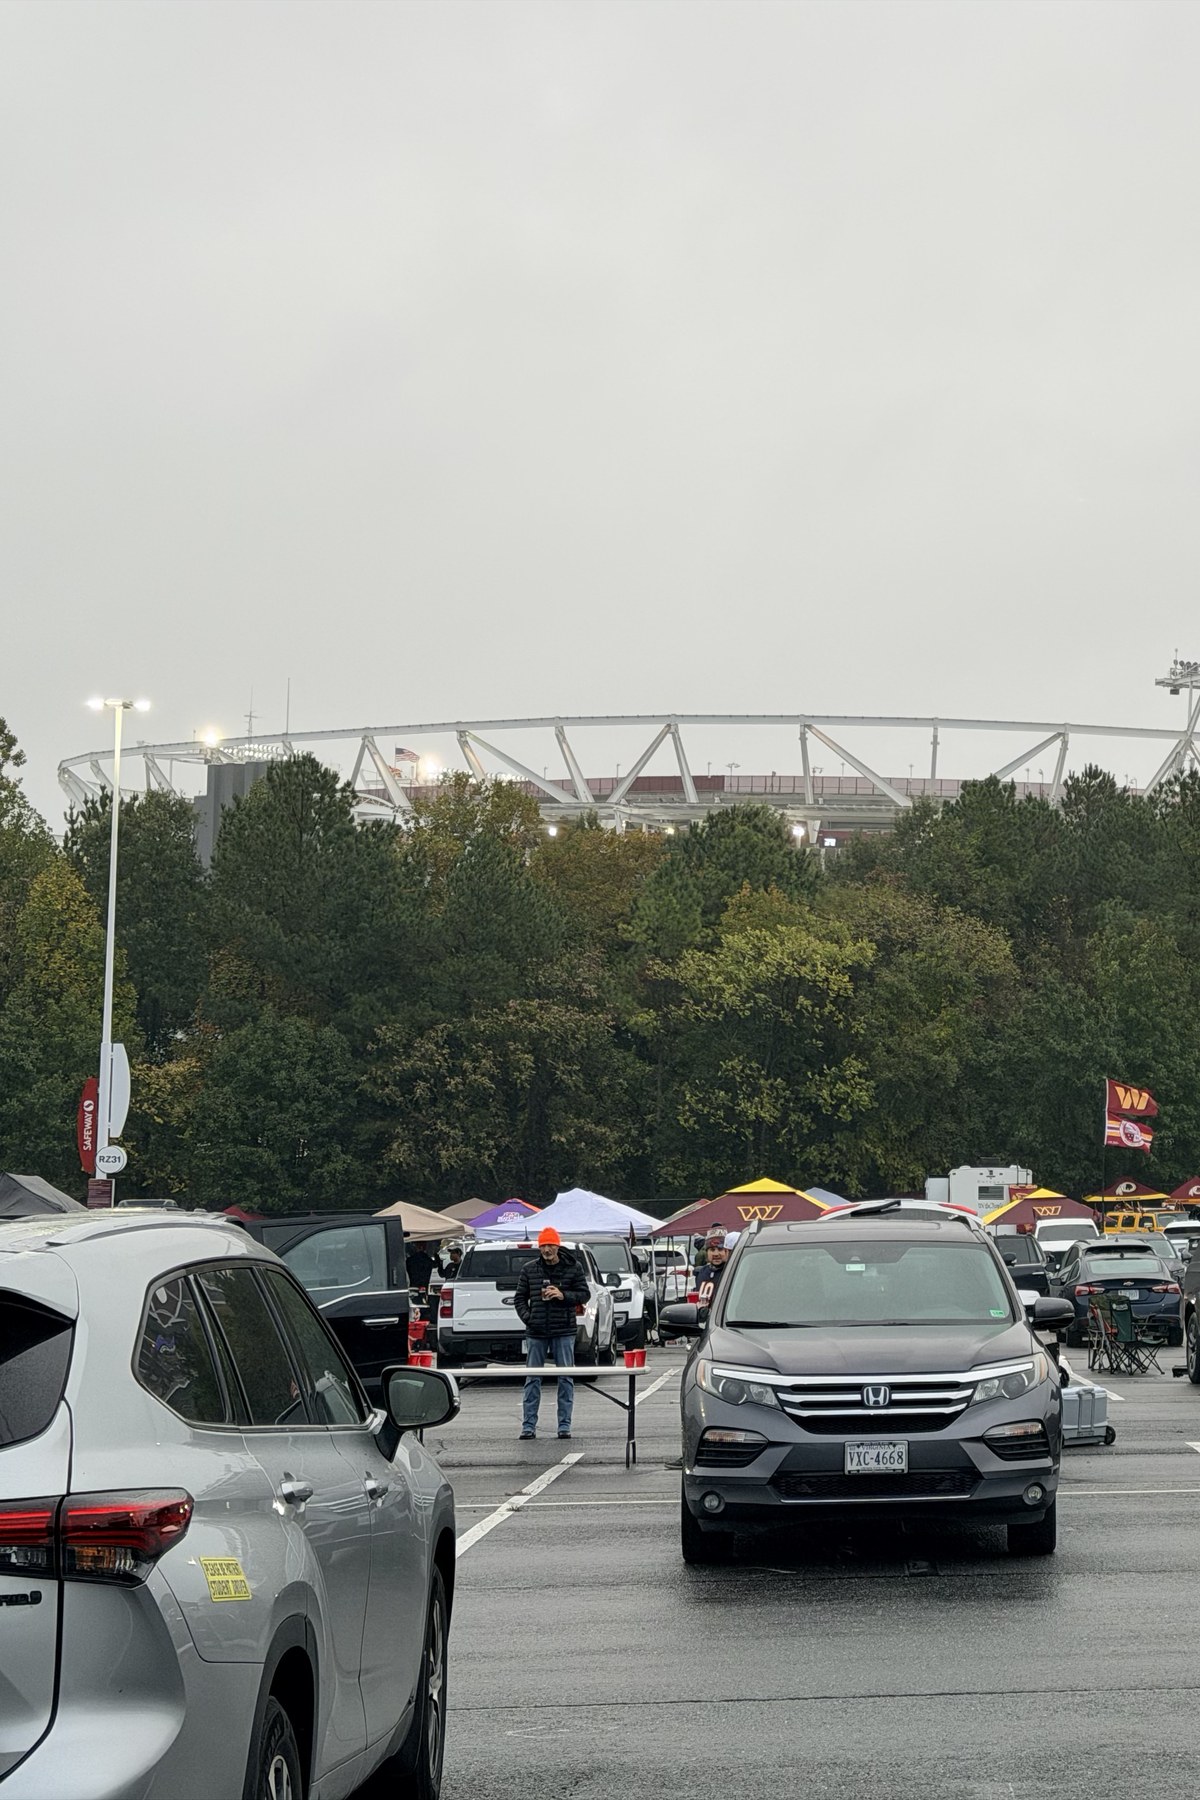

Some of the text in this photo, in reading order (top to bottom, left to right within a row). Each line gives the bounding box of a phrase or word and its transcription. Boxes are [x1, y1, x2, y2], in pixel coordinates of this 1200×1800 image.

[83, 1112, 92, 1151] SAFEWAY
[98, 1155, 121, 1164] RZ31
[848, 1451, 904, 1467] VXC-4668
[203, 1562, 223, 1577] PLEASE
[210, 1580, 250, 1596] STUDENT DRIVER
